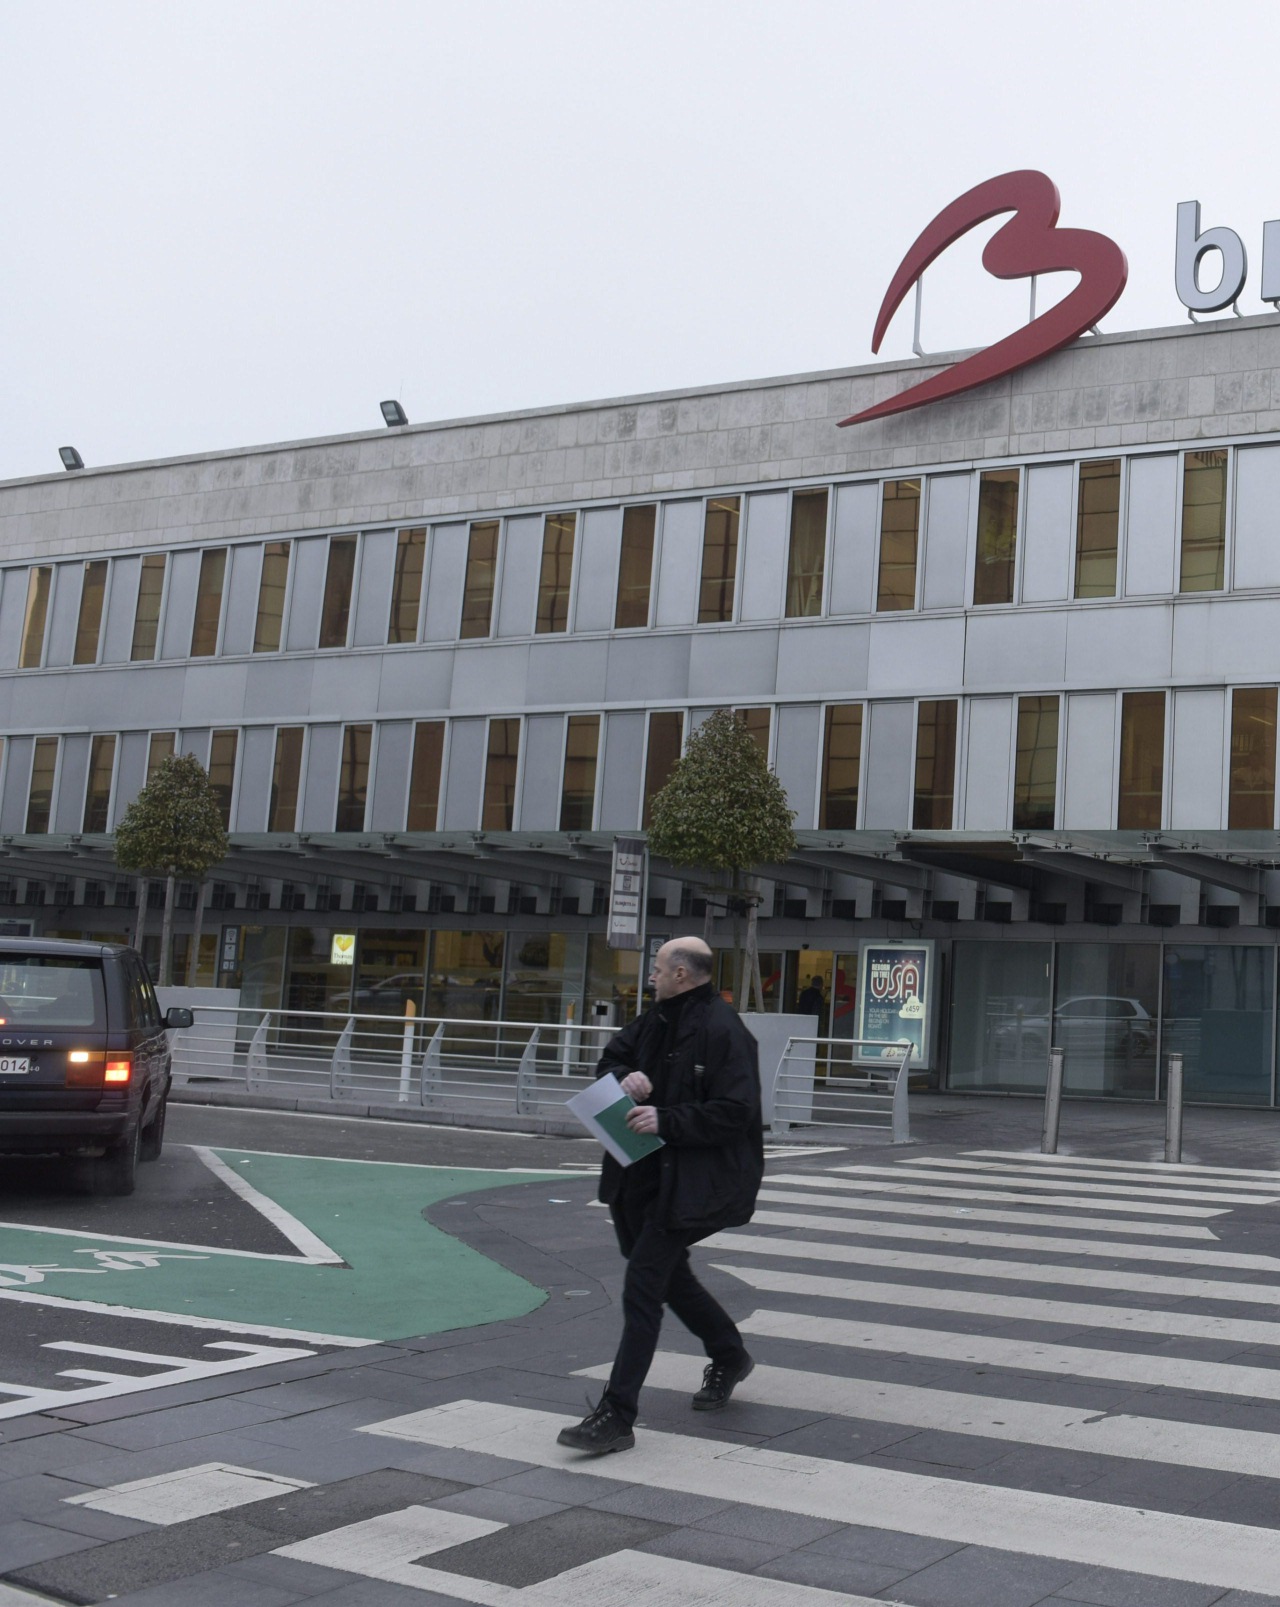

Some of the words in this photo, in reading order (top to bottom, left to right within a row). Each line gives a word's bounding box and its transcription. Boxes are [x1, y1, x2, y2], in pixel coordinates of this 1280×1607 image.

[334, 952, 353, 960] Thomas
[871, 964, 919, 999] USA
[0, 1059, 27, 1072] 014
